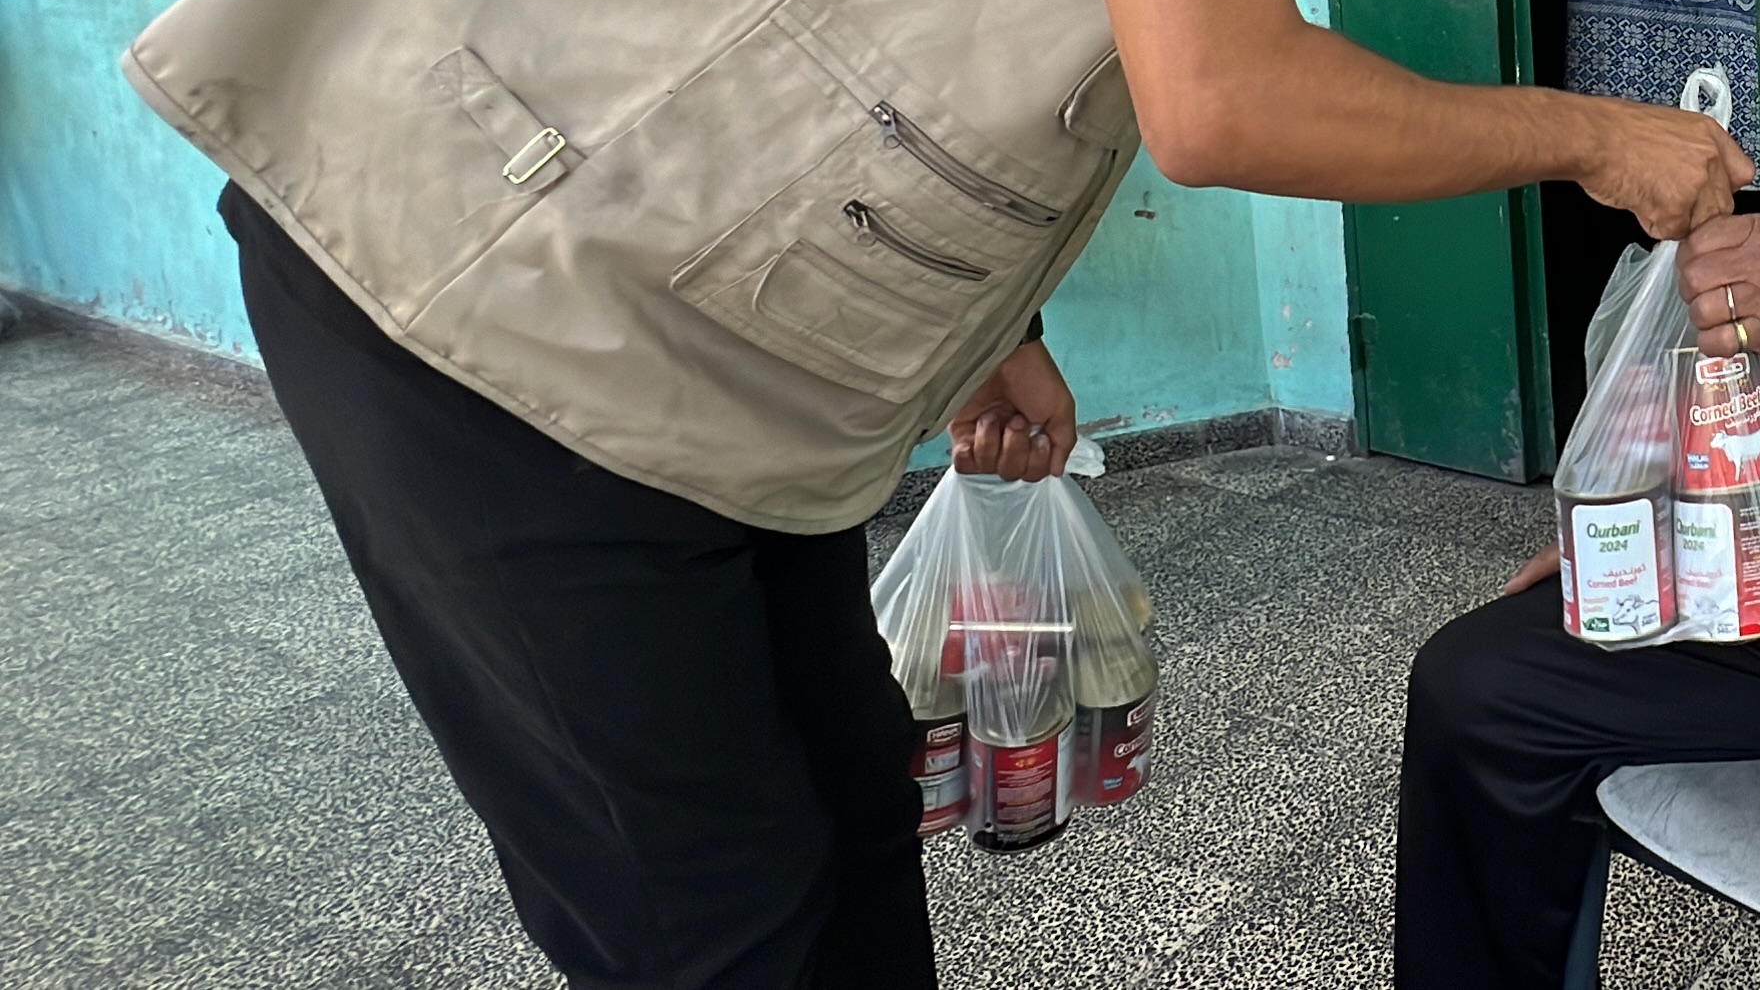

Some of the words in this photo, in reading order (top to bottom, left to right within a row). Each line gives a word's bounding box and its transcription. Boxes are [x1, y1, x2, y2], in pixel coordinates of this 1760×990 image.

[1690, 398, 1738, 425] Corned
[1586, 520, 1641, 538] Qurbani
[1599, 539, 1628, 553] 2024
